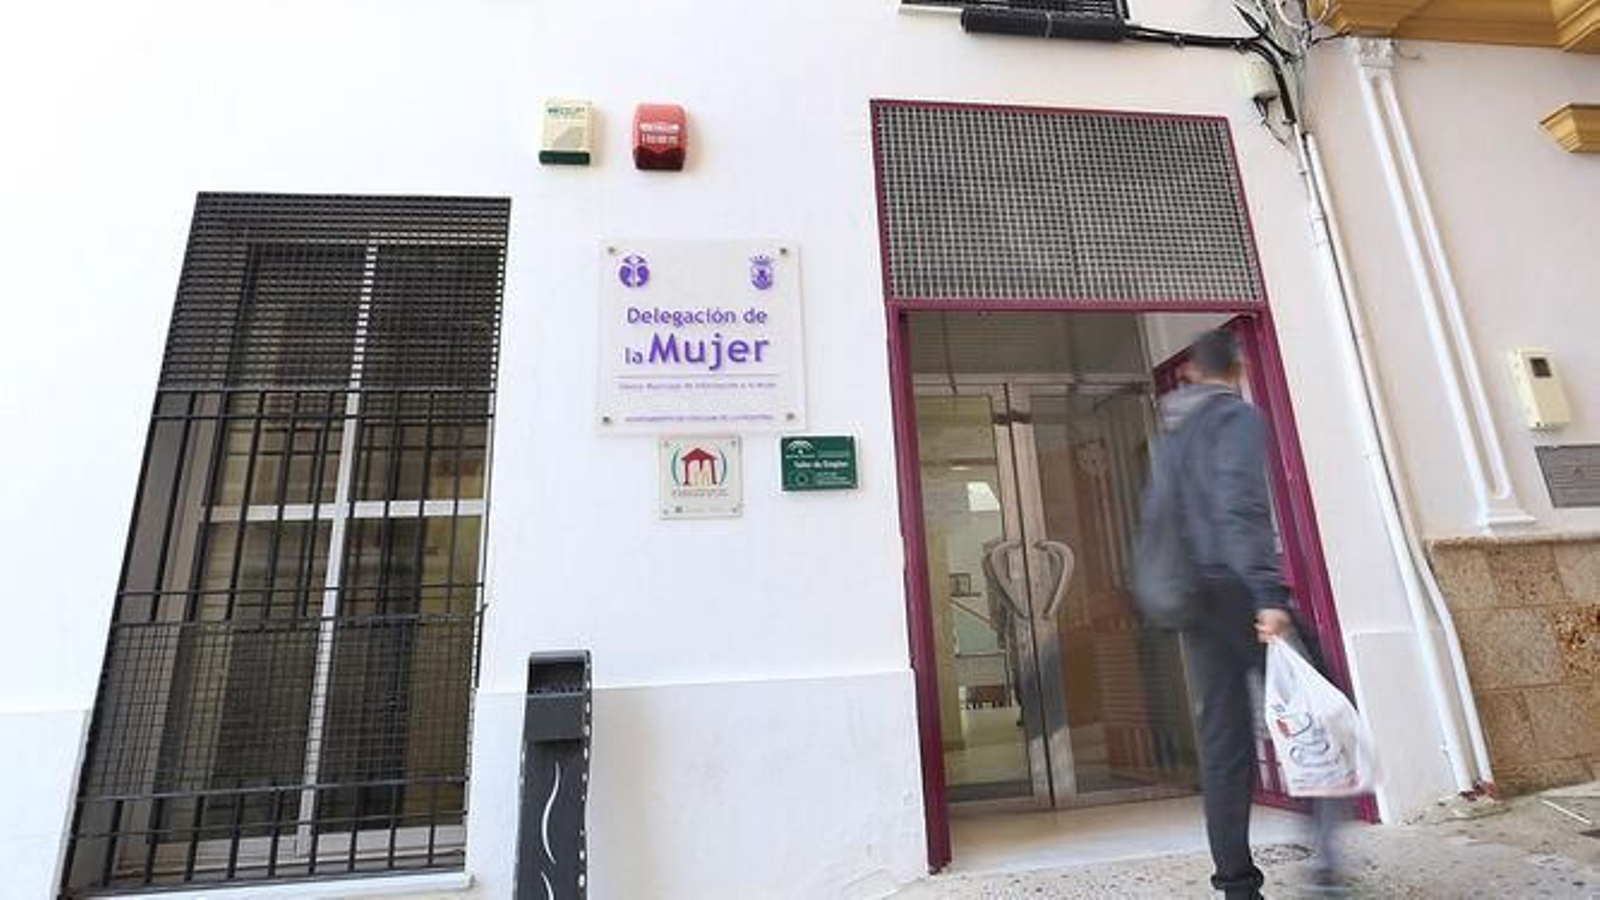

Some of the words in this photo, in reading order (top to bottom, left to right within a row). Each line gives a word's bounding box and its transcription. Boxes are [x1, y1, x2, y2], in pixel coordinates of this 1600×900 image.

[627, 306, 736, 328] Delegación
[742, 308, 768, 324] de
[625, 347, 643, 364] la
[649, 332, 770, 371] Mujer
